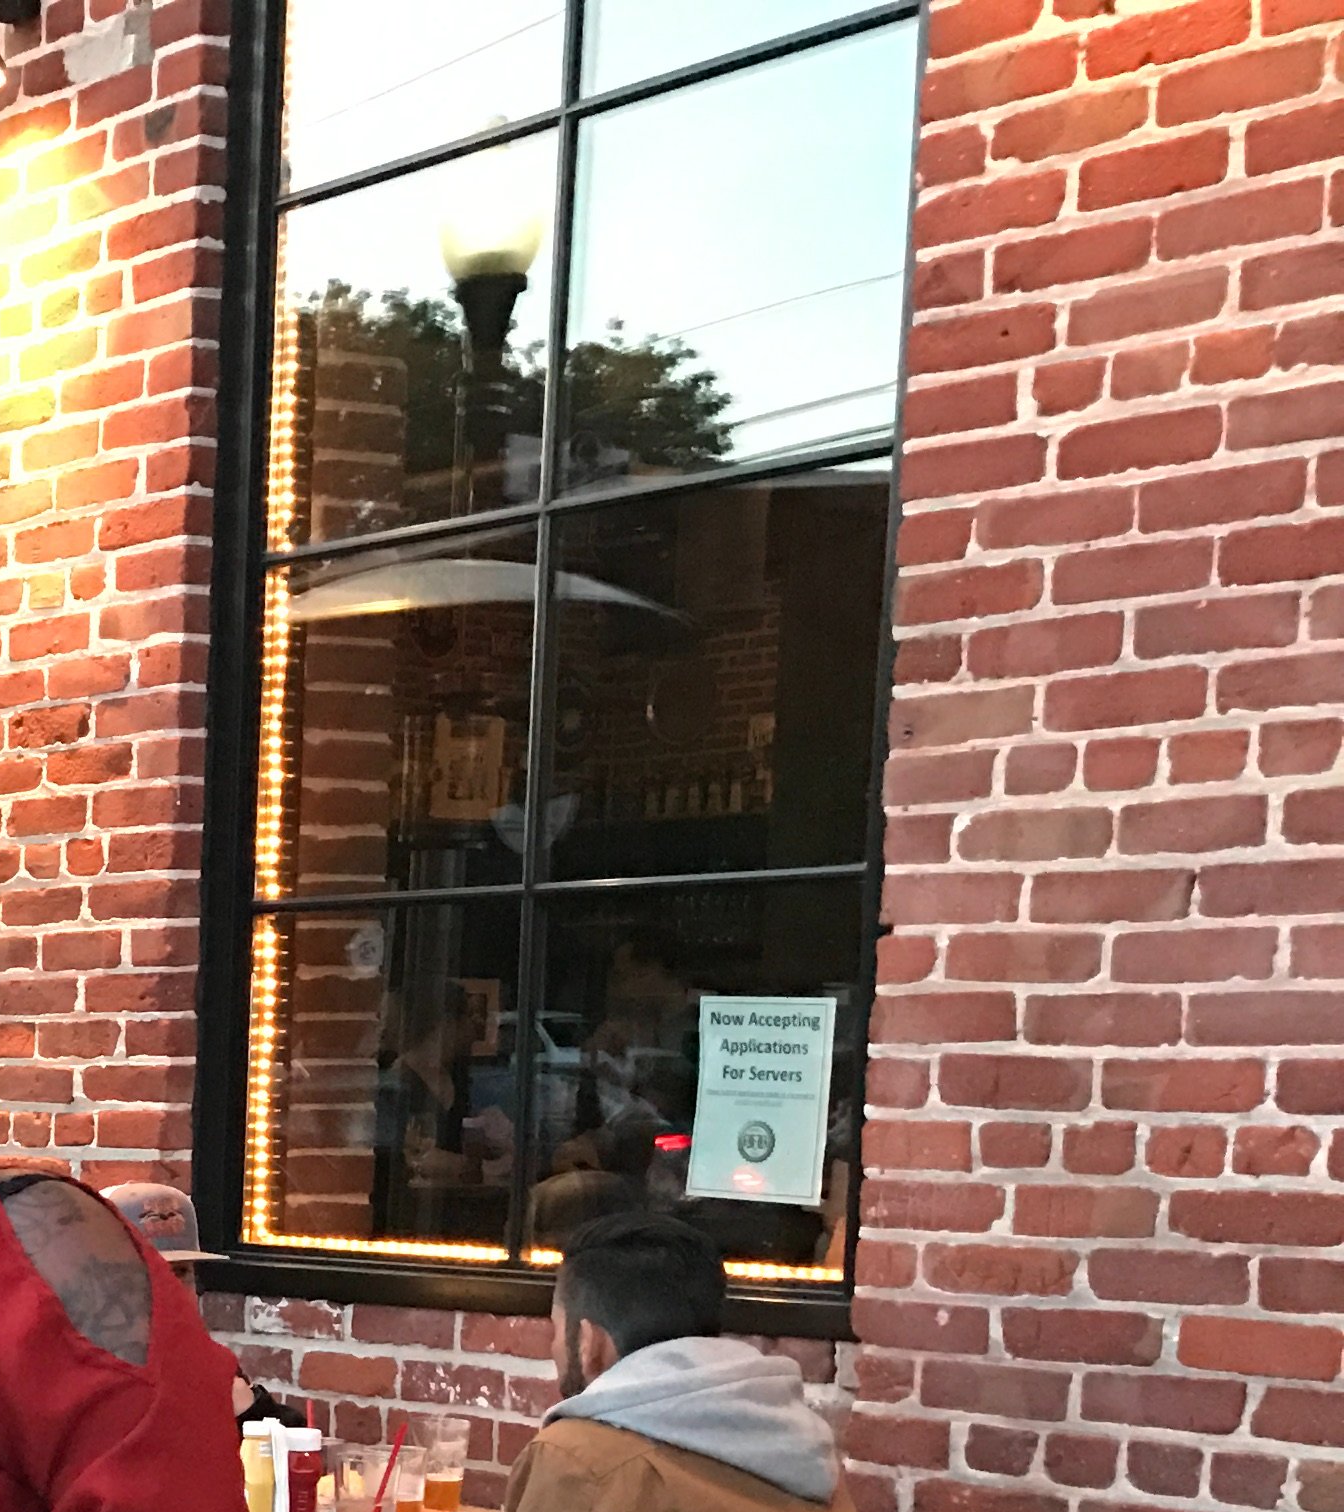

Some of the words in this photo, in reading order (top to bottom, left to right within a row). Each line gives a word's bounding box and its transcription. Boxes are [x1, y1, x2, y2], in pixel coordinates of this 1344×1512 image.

[710, 1012, 744, 1026] Now
[748, 1011, 820, 1031] Accepting
[720, 1038, 809, 1056] Applications
[722, 1064, 745, 1080] For
[748, 1065, 802, 1082] Servers
